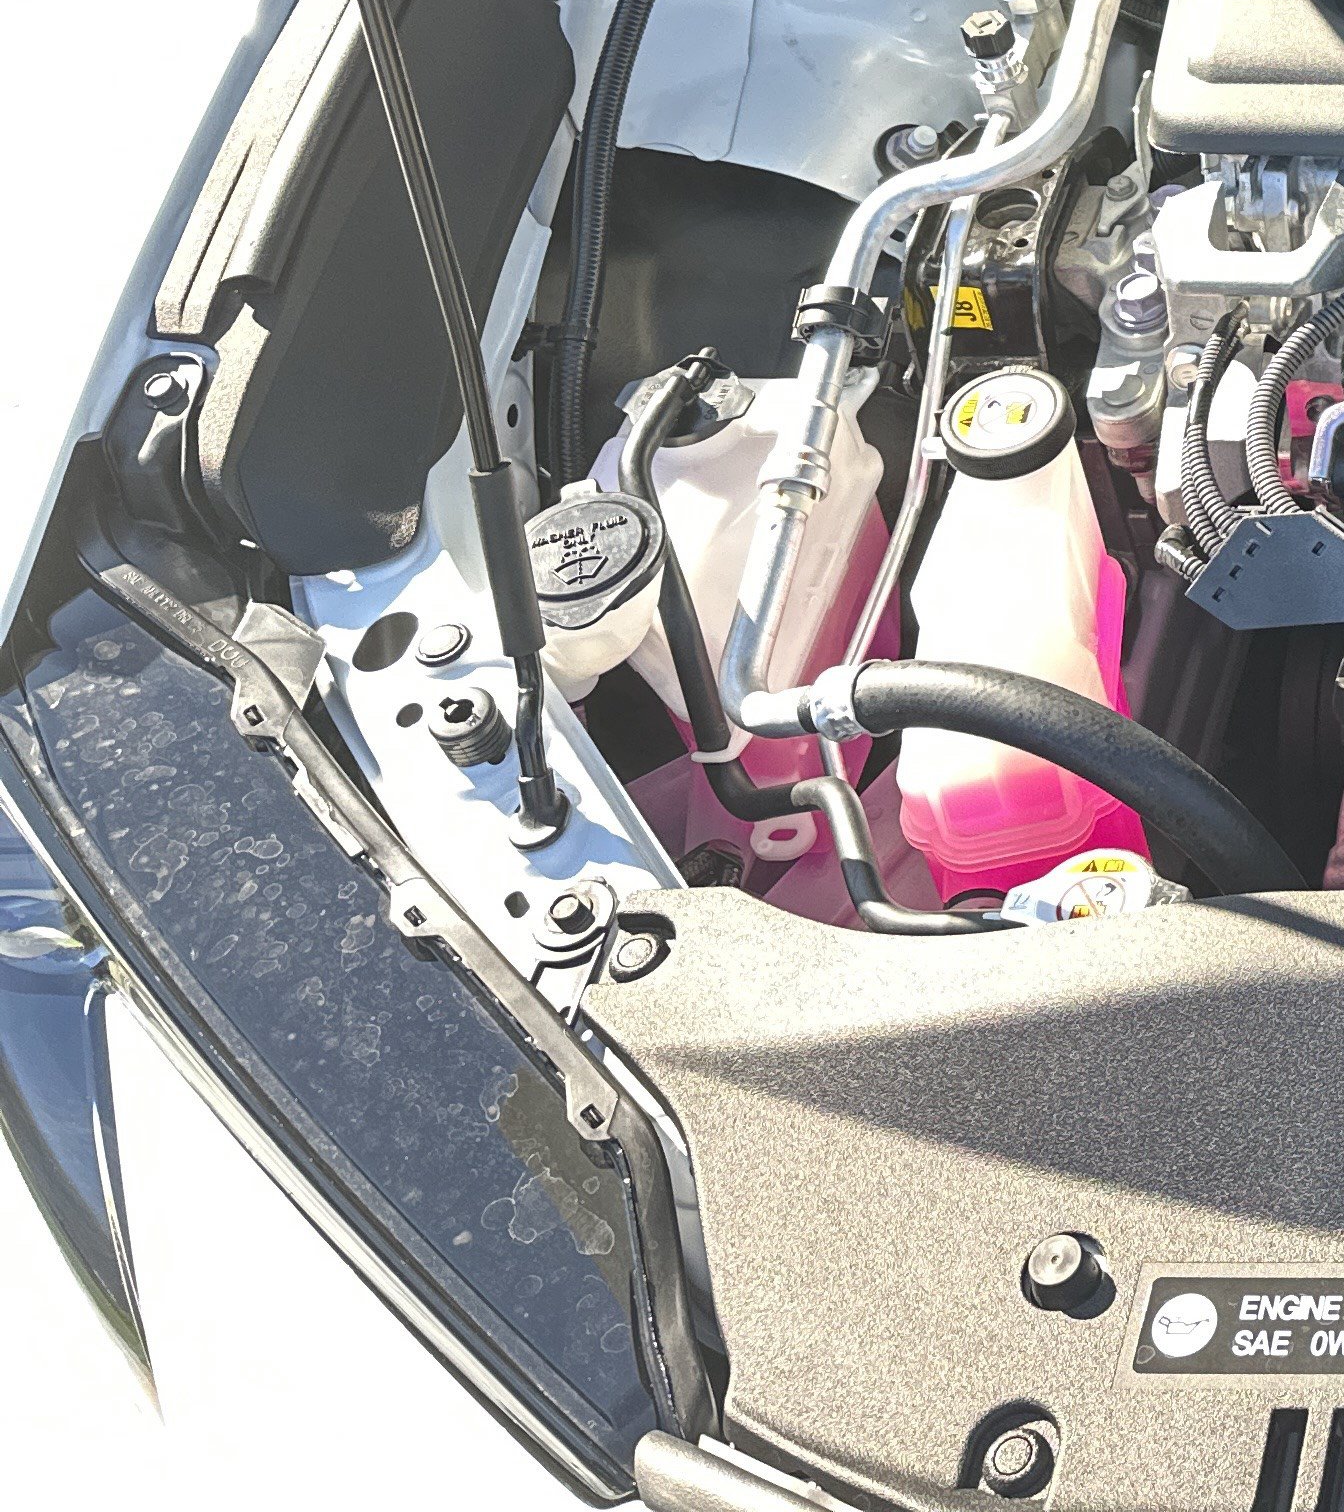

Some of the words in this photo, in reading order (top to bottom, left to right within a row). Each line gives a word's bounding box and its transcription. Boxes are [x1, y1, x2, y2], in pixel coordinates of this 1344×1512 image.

[591, 516, 628, 532] FLUID
[1239, 1295, 1343, 1321] ENGINE
[1231, 1330, 1292, 1356] SAE
